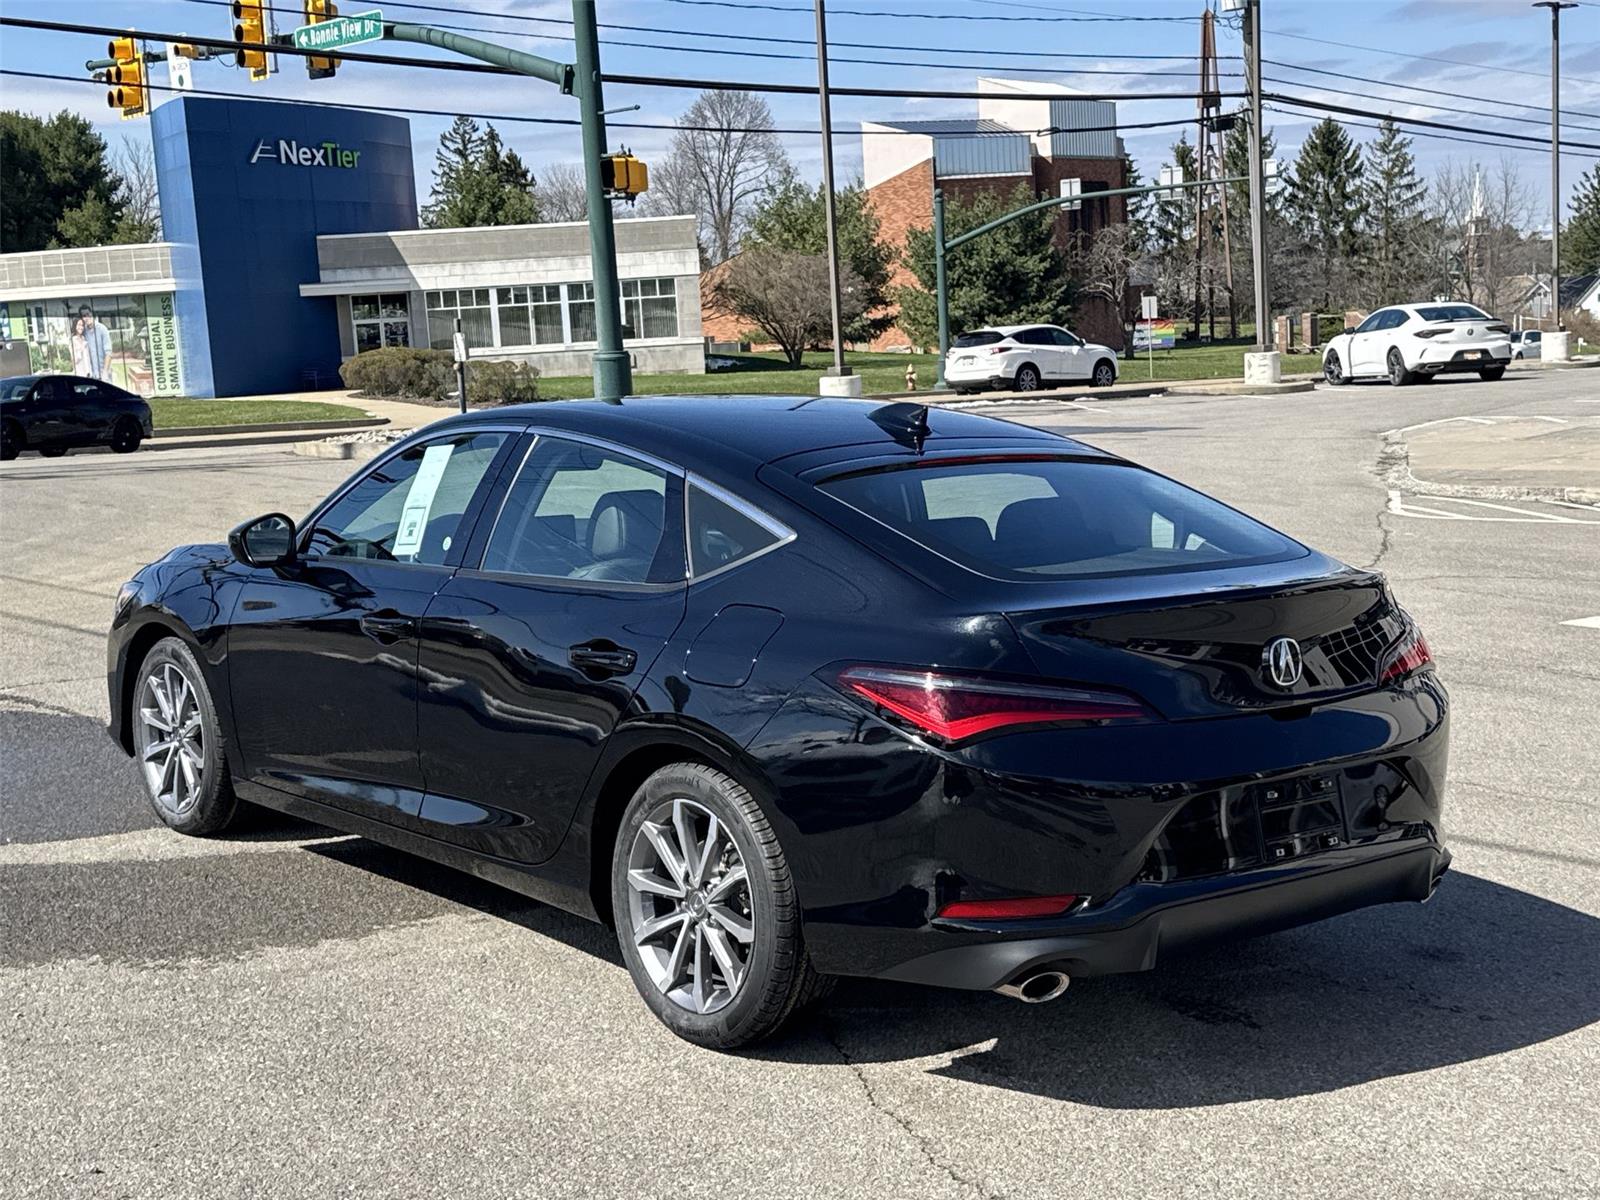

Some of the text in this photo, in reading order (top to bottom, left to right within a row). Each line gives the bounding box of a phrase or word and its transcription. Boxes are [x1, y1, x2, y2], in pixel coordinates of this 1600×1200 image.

[310, 24, 340, 45] Bonnie
[341, 21, 362, 39] View
[279, 140, 360, 168] NexTier
[151, 320, 167, 390] COMMERCIAL
[161, 296, 180, 389] SMALL BUSINESS
